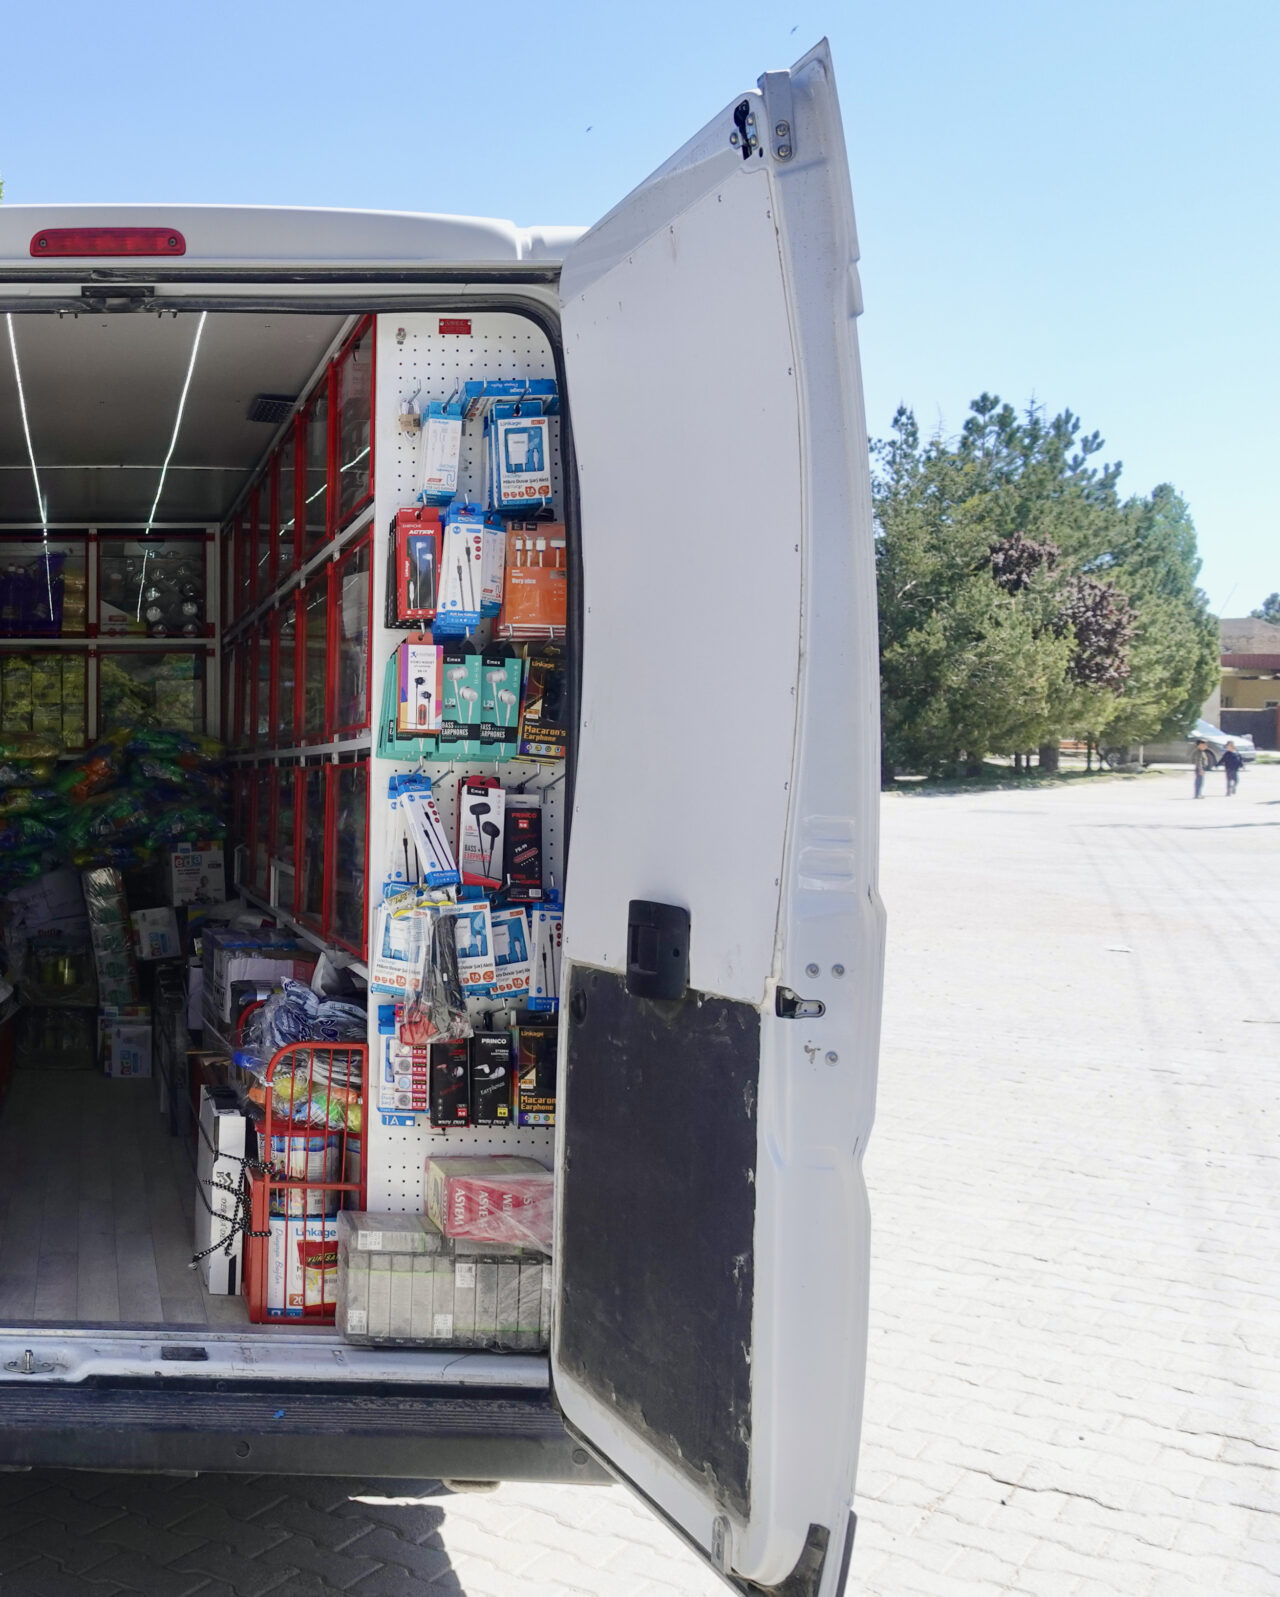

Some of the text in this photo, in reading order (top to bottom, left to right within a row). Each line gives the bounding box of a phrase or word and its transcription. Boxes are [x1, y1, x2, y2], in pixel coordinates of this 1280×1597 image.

[441, 728, 469, 736] EARPHONES
[524, 725, 566, 736] Macaron's
[523, 733, 557, 742] Earphone
[464, 844, 476, 853] BASS
[521, 1103, 554, 1111] Earphone
[385, 1116, 400, 1125] 1A
[455, 1187, 466, 1225] ASYEM
[296, 1228, 336, 1239] Lnkage
